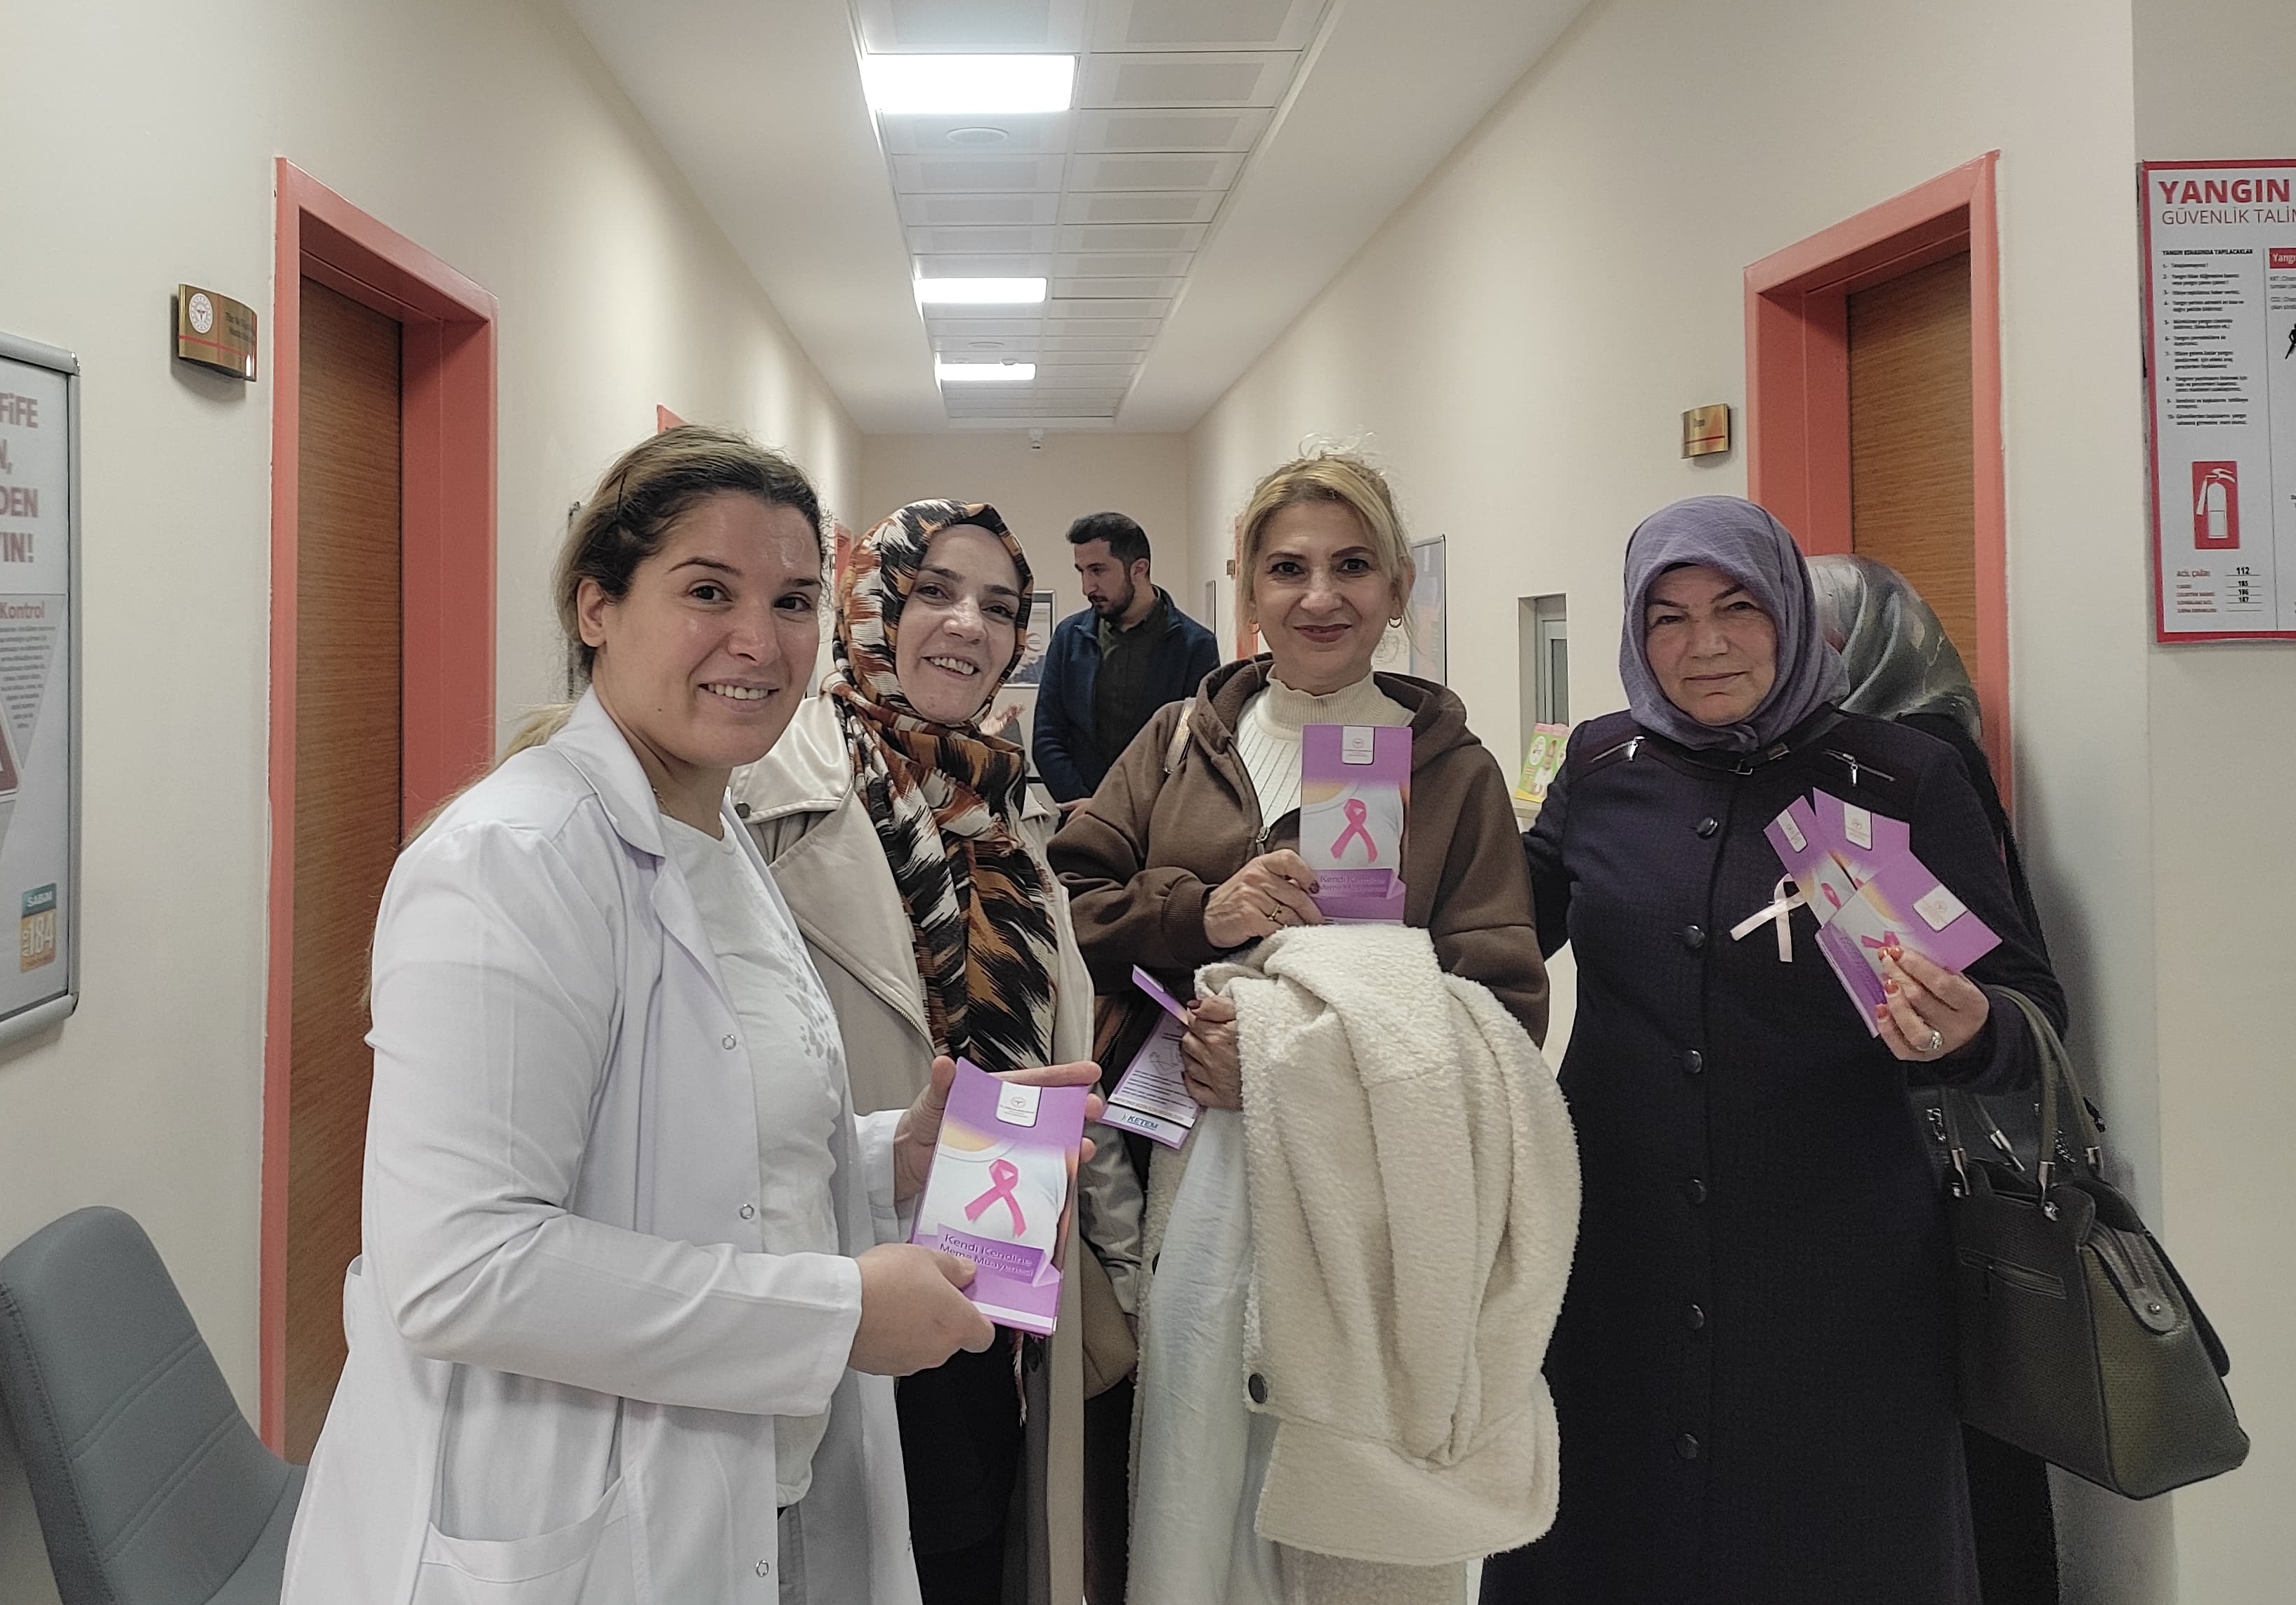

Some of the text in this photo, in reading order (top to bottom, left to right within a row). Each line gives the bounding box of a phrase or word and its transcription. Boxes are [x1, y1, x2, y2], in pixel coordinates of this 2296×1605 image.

[2158, 179, 2290, 204] YANGIN
[2163, 207, 2249, 225] GÜVENLİK
[1128, 1115, 1159, 1129] KETEM
[945, 1233, 978, 1253] Kendi
